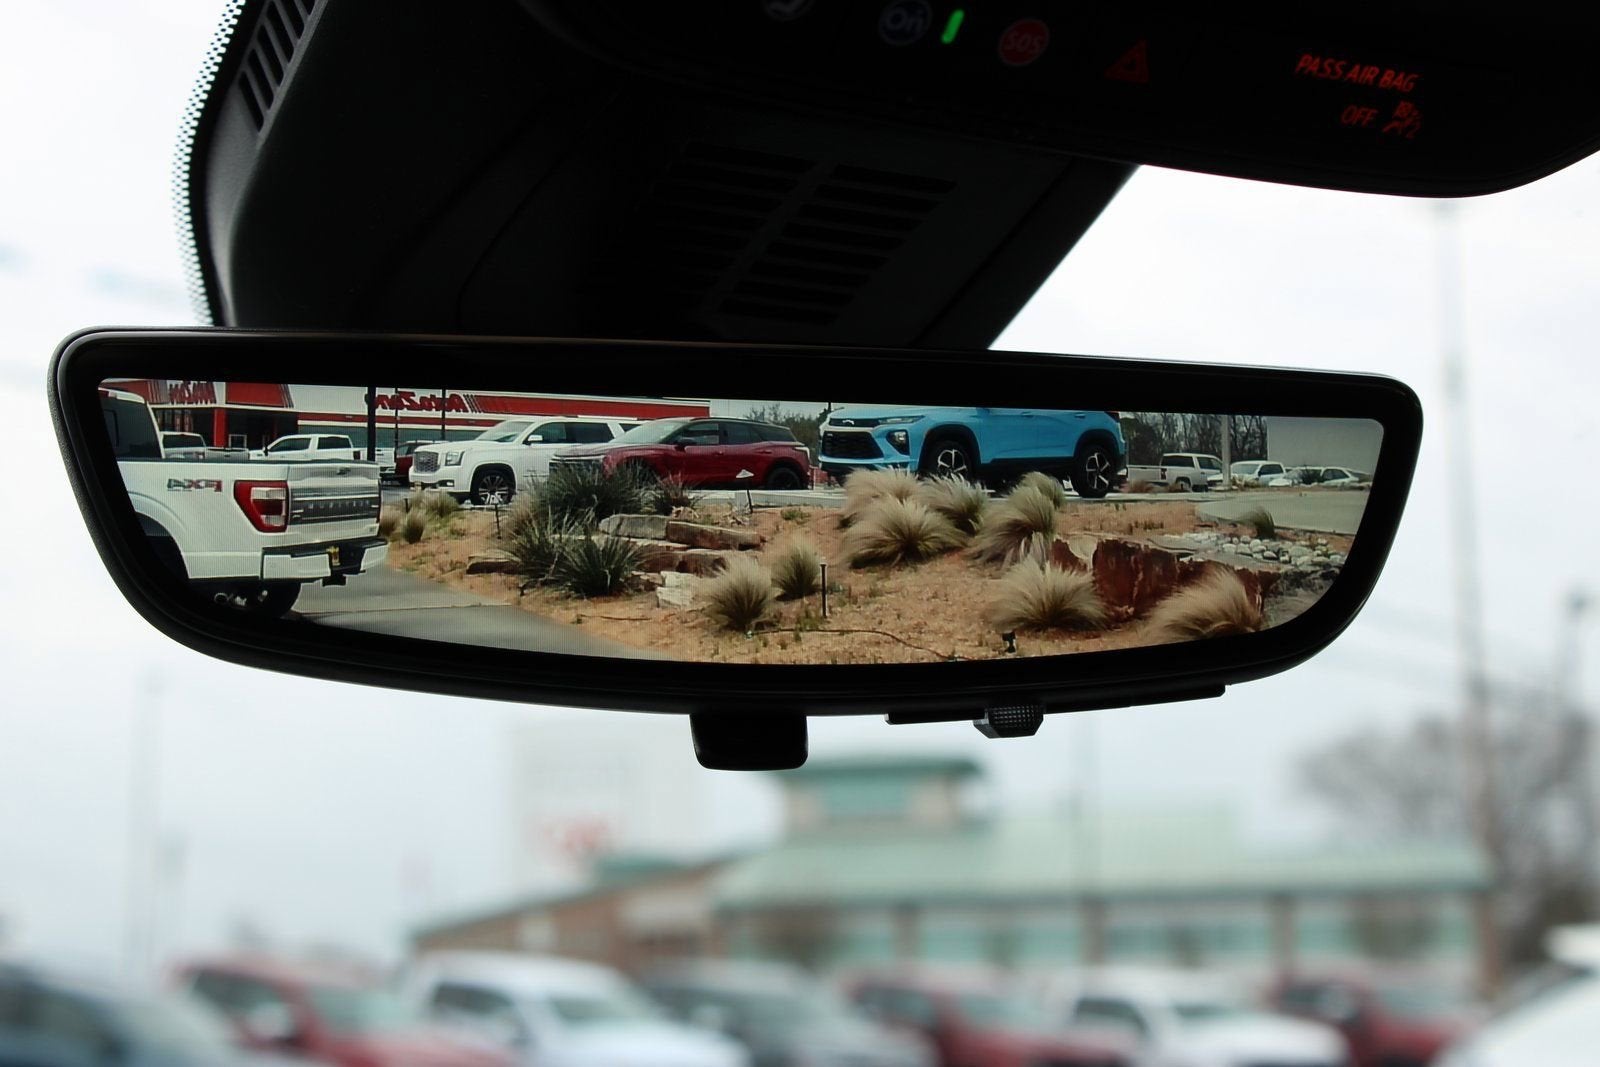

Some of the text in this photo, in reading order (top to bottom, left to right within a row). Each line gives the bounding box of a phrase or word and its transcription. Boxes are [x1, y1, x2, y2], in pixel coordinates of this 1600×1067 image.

[1003, 29, 1042, 54] SOS
[1295, 53, 1420, 95] PASS AIR BAG
[1340, 103, 1380, 129] OFF
